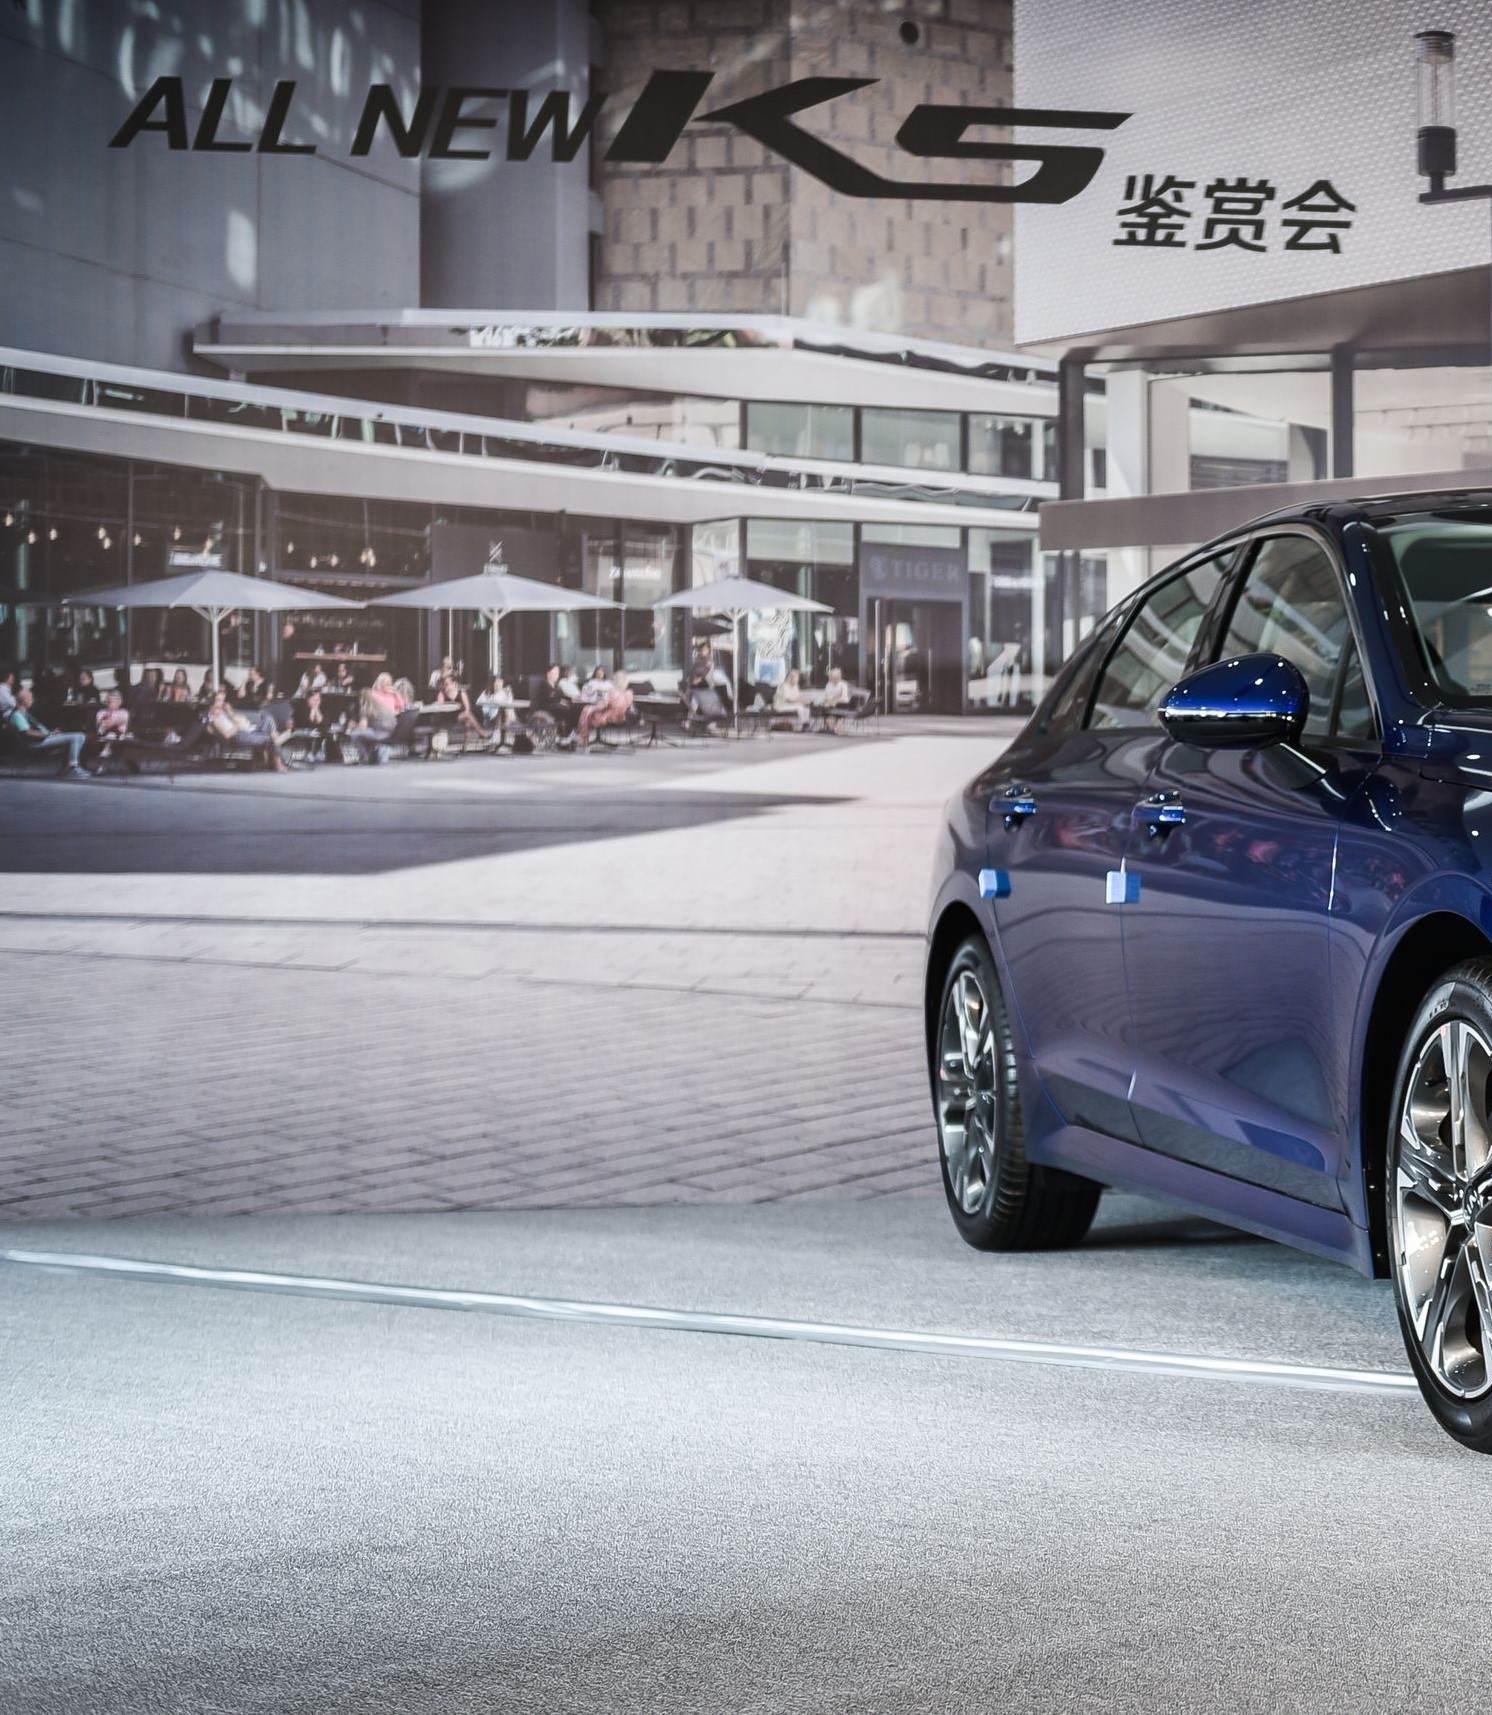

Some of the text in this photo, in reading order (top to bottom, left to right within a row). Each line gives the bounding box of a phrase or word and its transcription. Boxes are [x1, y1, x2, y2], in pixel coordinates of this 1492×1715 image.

[108, 76, 316, 153] ALL
[351, 84, 607, 163] NEW
[1113, 175, 1356, 254] 鉴赏会
[892, 560, 960, 581] TIGER
